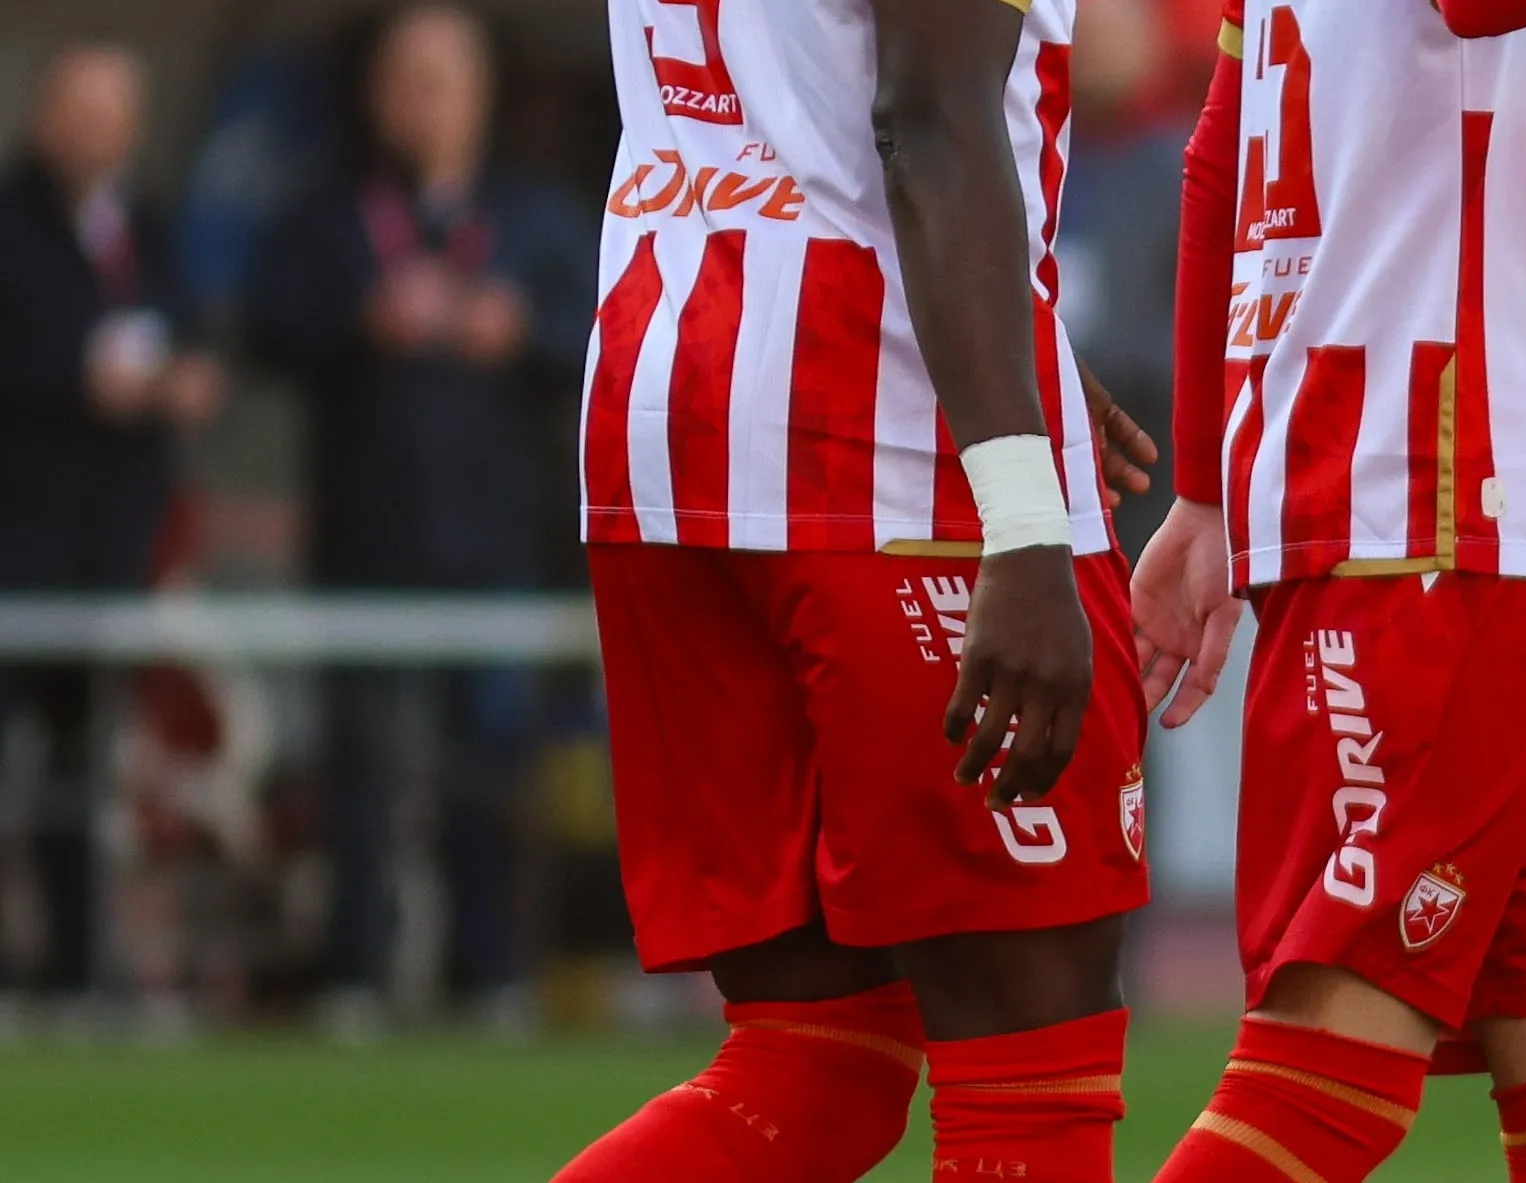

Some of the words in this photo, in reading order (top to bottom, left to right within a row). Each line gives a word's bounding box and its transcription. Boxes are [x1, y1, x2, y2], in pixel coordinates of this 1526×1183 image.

[660, 85, 737, 114] OZZART
[1262, 256, 1311, 278] FUE
[895, 578, 940, 663] FUEL
[1302, 632, 1319, 715] FUEL
